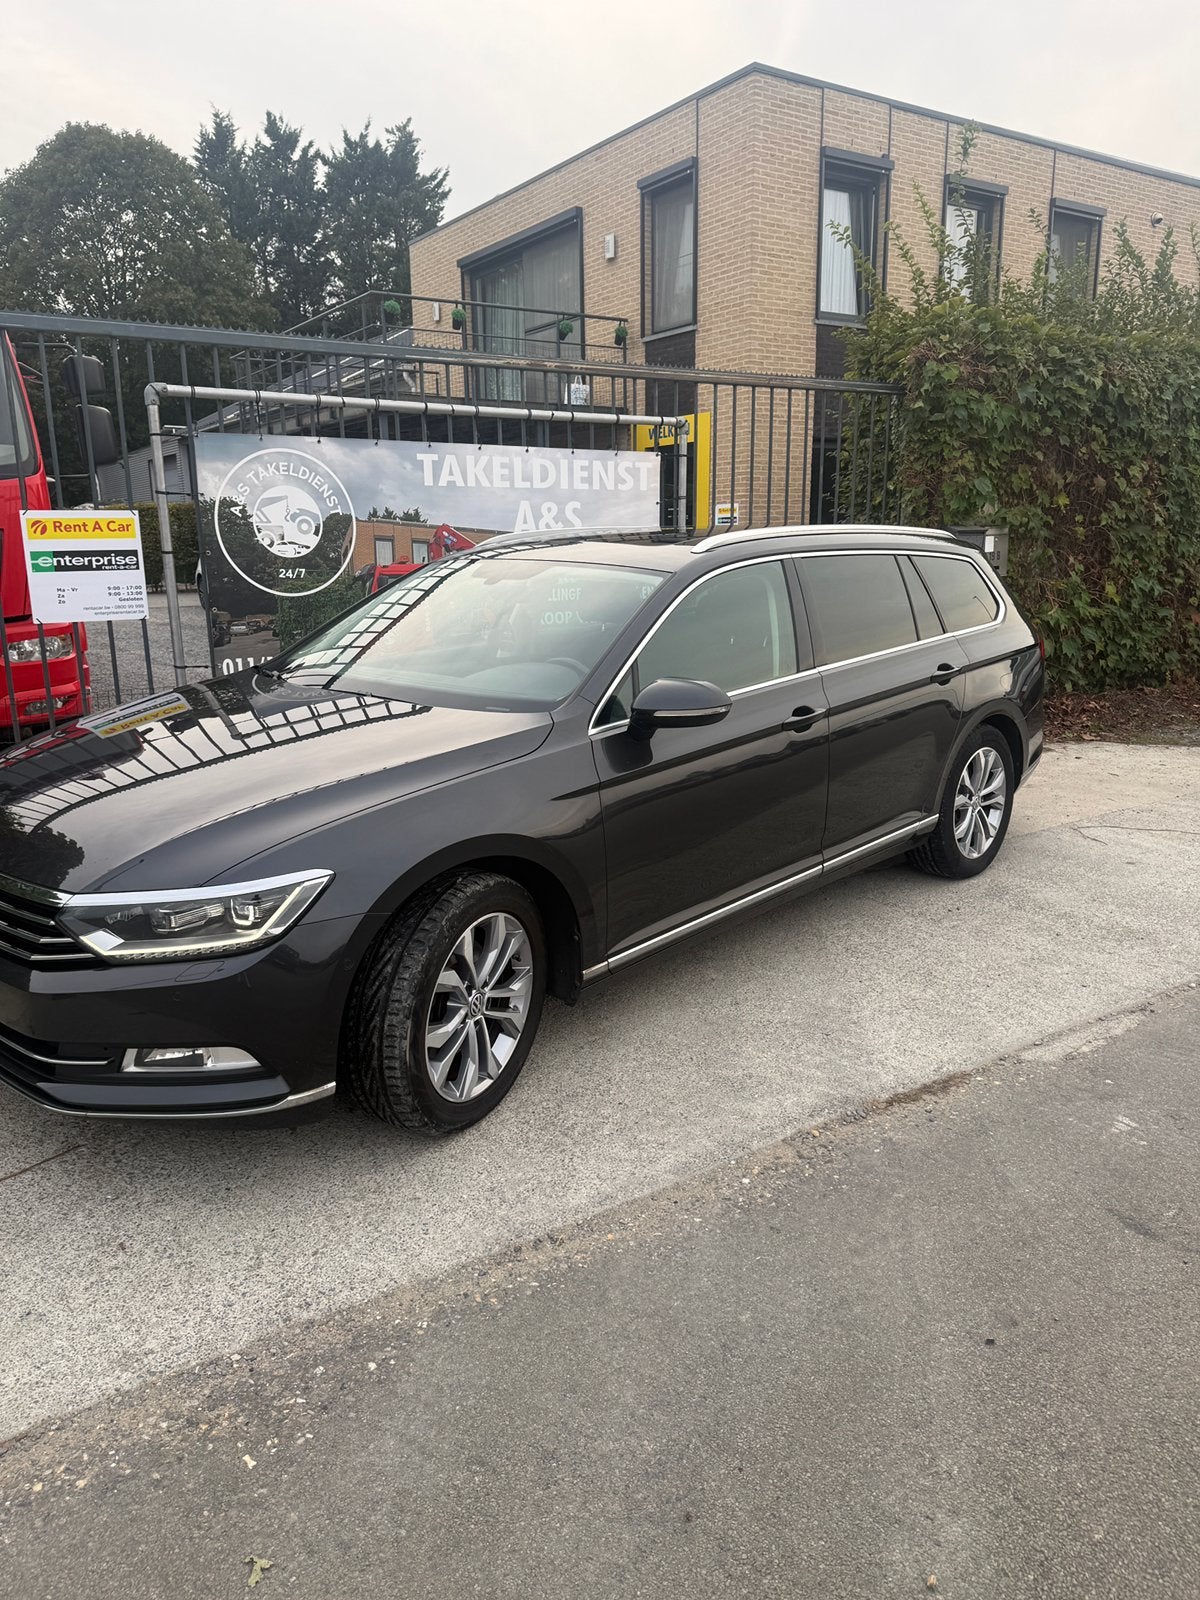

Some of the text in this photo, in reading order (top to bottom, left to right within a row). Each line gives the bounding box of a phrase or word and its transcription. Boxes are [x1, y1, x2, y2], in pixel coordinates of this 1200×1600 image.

[416, 452, 653, 492] TAKELDIENST
[230, 462, 342, 517] A&S TAKELDIENST
[52, 520, 132, 533] Rent A Car
[513, 499, 582, 533] A&S
[36, 553, 138, 568] enterprise
[278, 567, 306, 579] 24/7
